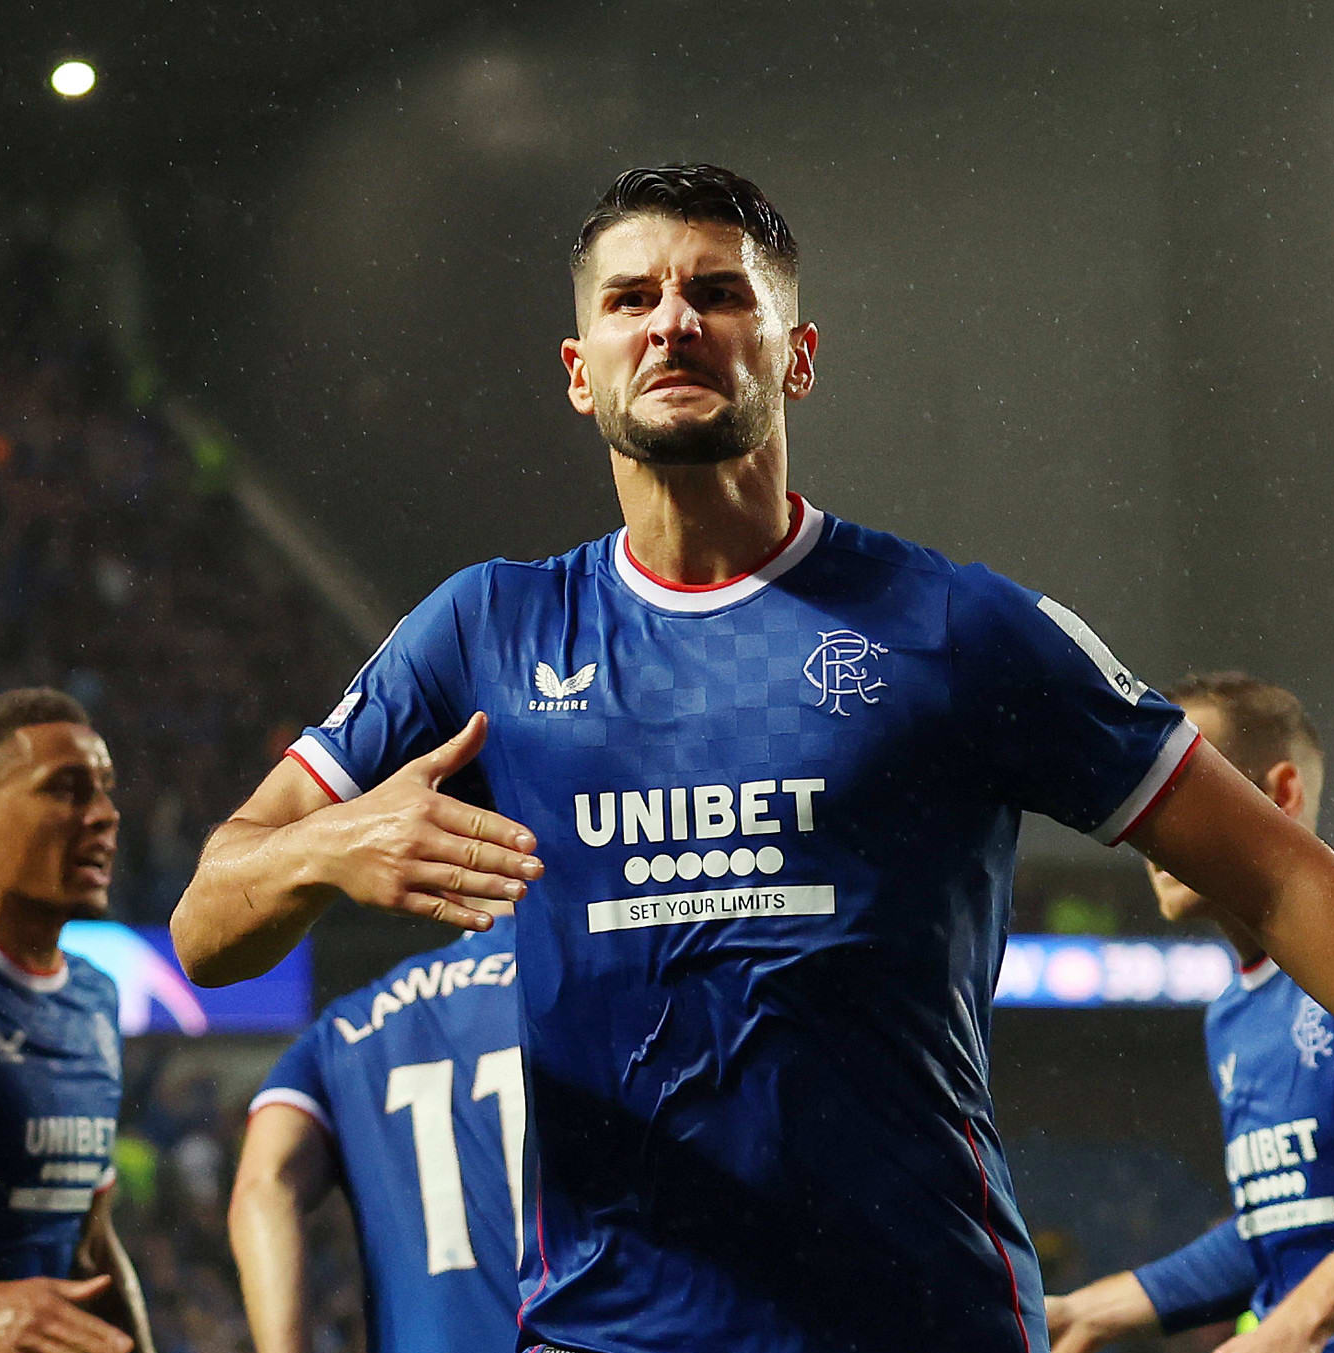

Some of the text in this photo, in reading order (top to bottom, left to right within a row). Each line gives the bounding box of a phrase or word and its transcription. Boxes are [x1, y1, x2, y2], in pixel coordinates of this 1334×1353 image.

[529, 700, 588, 711] CASTORE
[574, 778, 826, 847] UNIBET
[630, 893, 785, 920] SET YOUR LIMITS
[333, 952, 516, 1044] LAWRE
[384, 1045, 526, 1276] 11
